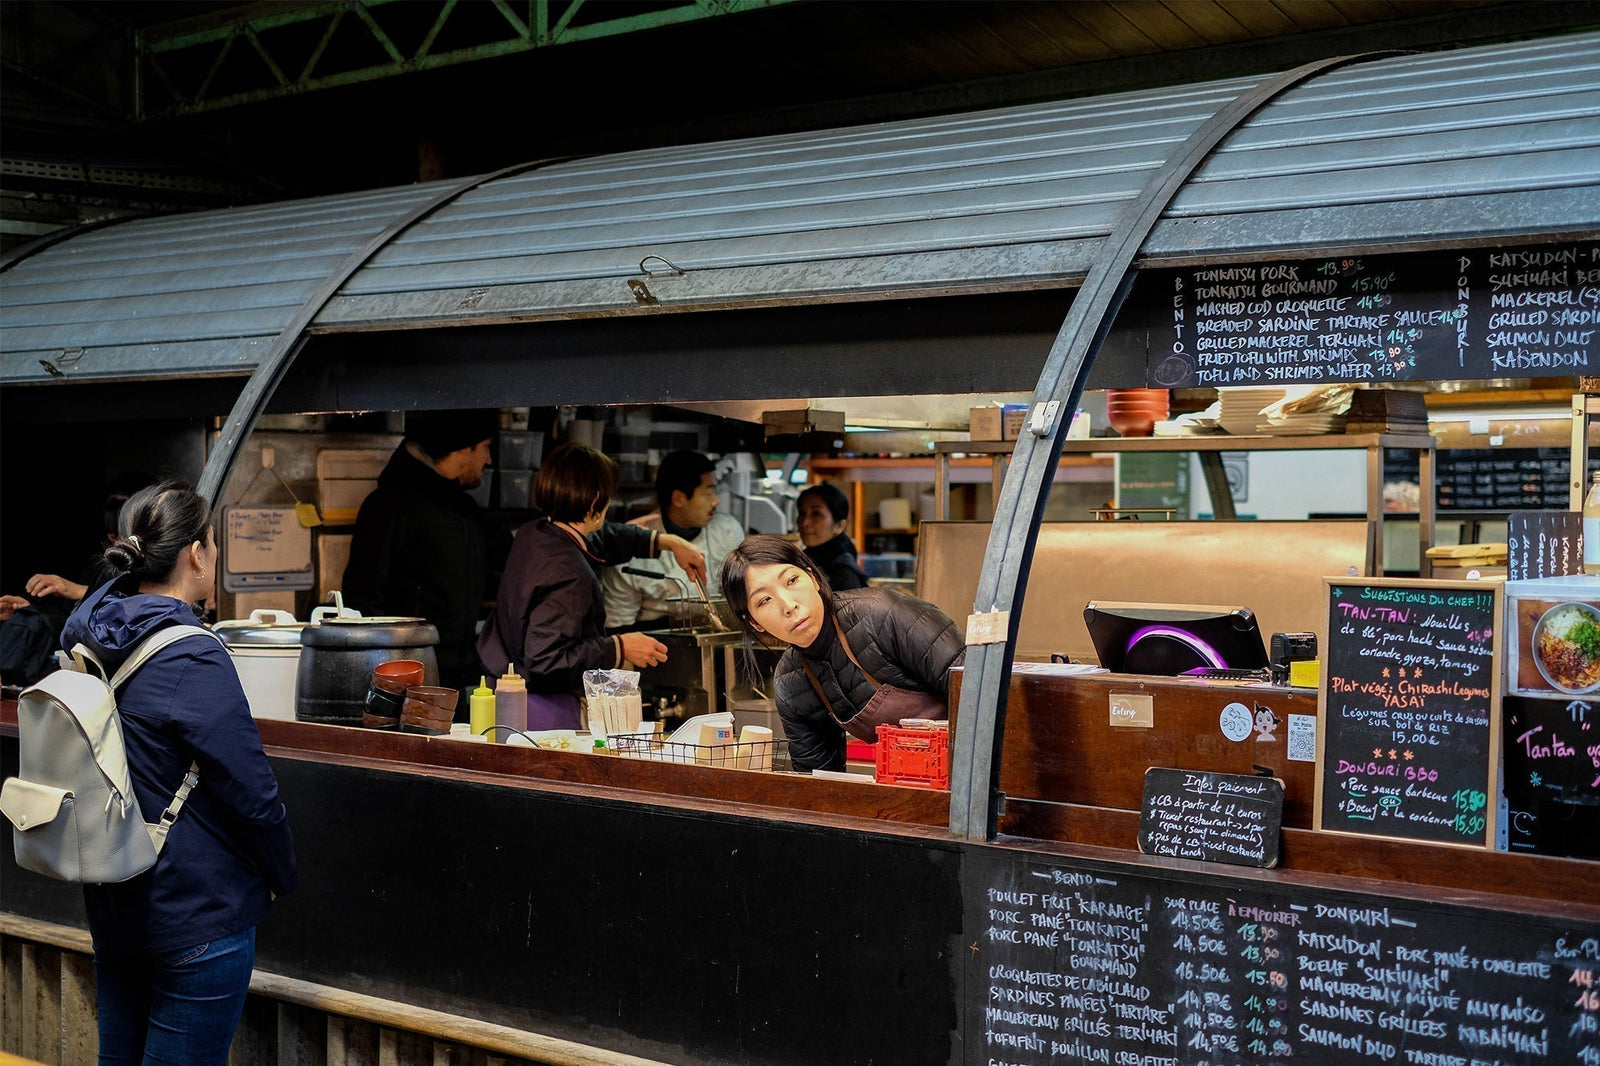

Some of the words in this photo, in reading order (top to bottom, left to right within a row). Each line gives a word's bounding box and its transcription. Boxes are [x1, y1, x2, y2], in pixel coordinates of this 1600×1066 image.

[1489, 247, 1577, 268] KATSUDON
[1194, 267, 1256, 282] TONKATSU
[1261, 265, 1299, 280] PORK
[1194, 284, 1256, 300] TONKATSU
[1262, 279, 1338, 298] GOURMAND
[1491, 290, 1577, 308] MACKEREL
[1196, 302, 1245, 316] MASHED
[1247, 300, 1272, 317] COD
[1276, 296, 1352, 318] CROQUETTE
[1196, 319, 1253, 335] BREADED
[1325, 314, 1391, 332] TARTARE
[1394, 310, 1442, 327] SAUCE
[1247, 334, 1314, 349] MACKEREL
[1486, 331, 1550, 348] SALMON
[1554, 330, 1595, 347] DUO
[1235, 351, 1264, 365] TOFU
[1195, 369, 1230, 386] TOFU
[1233, 367, 1261, 381] AND
[1340, 622, 1355, 634] de
[1383, 632, 1404, 646] porc
[1332, 676, 1360, 694] Plat
[1342, 704, 1388, 720] Légumes
[1403, 766, 1439, 782] BBQ
[1182, 774, 1213, 794] Infos
[1217, 781, 1267, 798] paiement
[1348, 777, 1368, 792] Porc
[1371, 786, 1401, 796] sauce
[1405, 783, 1447, 803] barbecue
[1156, 794, 1173, 807] CB
[1181, 798, 1210, 813] partir
[1210, 799, 1222, 813] de
[1237, 809, 1261, 820] euros
[1171, 834, 1182, 844] de
[987, 887, 1039, 906] POULET
[988, 908, 1025, 924] PORC
[1029, 912, 1065, 930] PANÉ
[1164, 896, 1187, 910] SUR
[1189, 900, 1220, 914] PLACE
[1238, 906, 1302, 927] EMPORTER
[987, 925, 1022, 944] PORC
[1023, 930, 1059, 949] PANÉ
[1297, 929, 1381, 960] KATSUDON
[1396, 946, 1430, 964] PORC
[989, 964, 1062, 988] CROQUETTES
[1063, 975, 1081, 990] DE
[1070, 954, 1137, 979] GOURMAND
[1059, 993, 1107, 1014] PANÉES
[1299, 976, 1402, 1007] MAQUEREAUX
[1466, 999, 1500, 1020] AUX
[1298, 1023, 1363, 1053] SAUMON
[1365, 1039, 1396, 1062] DUO
